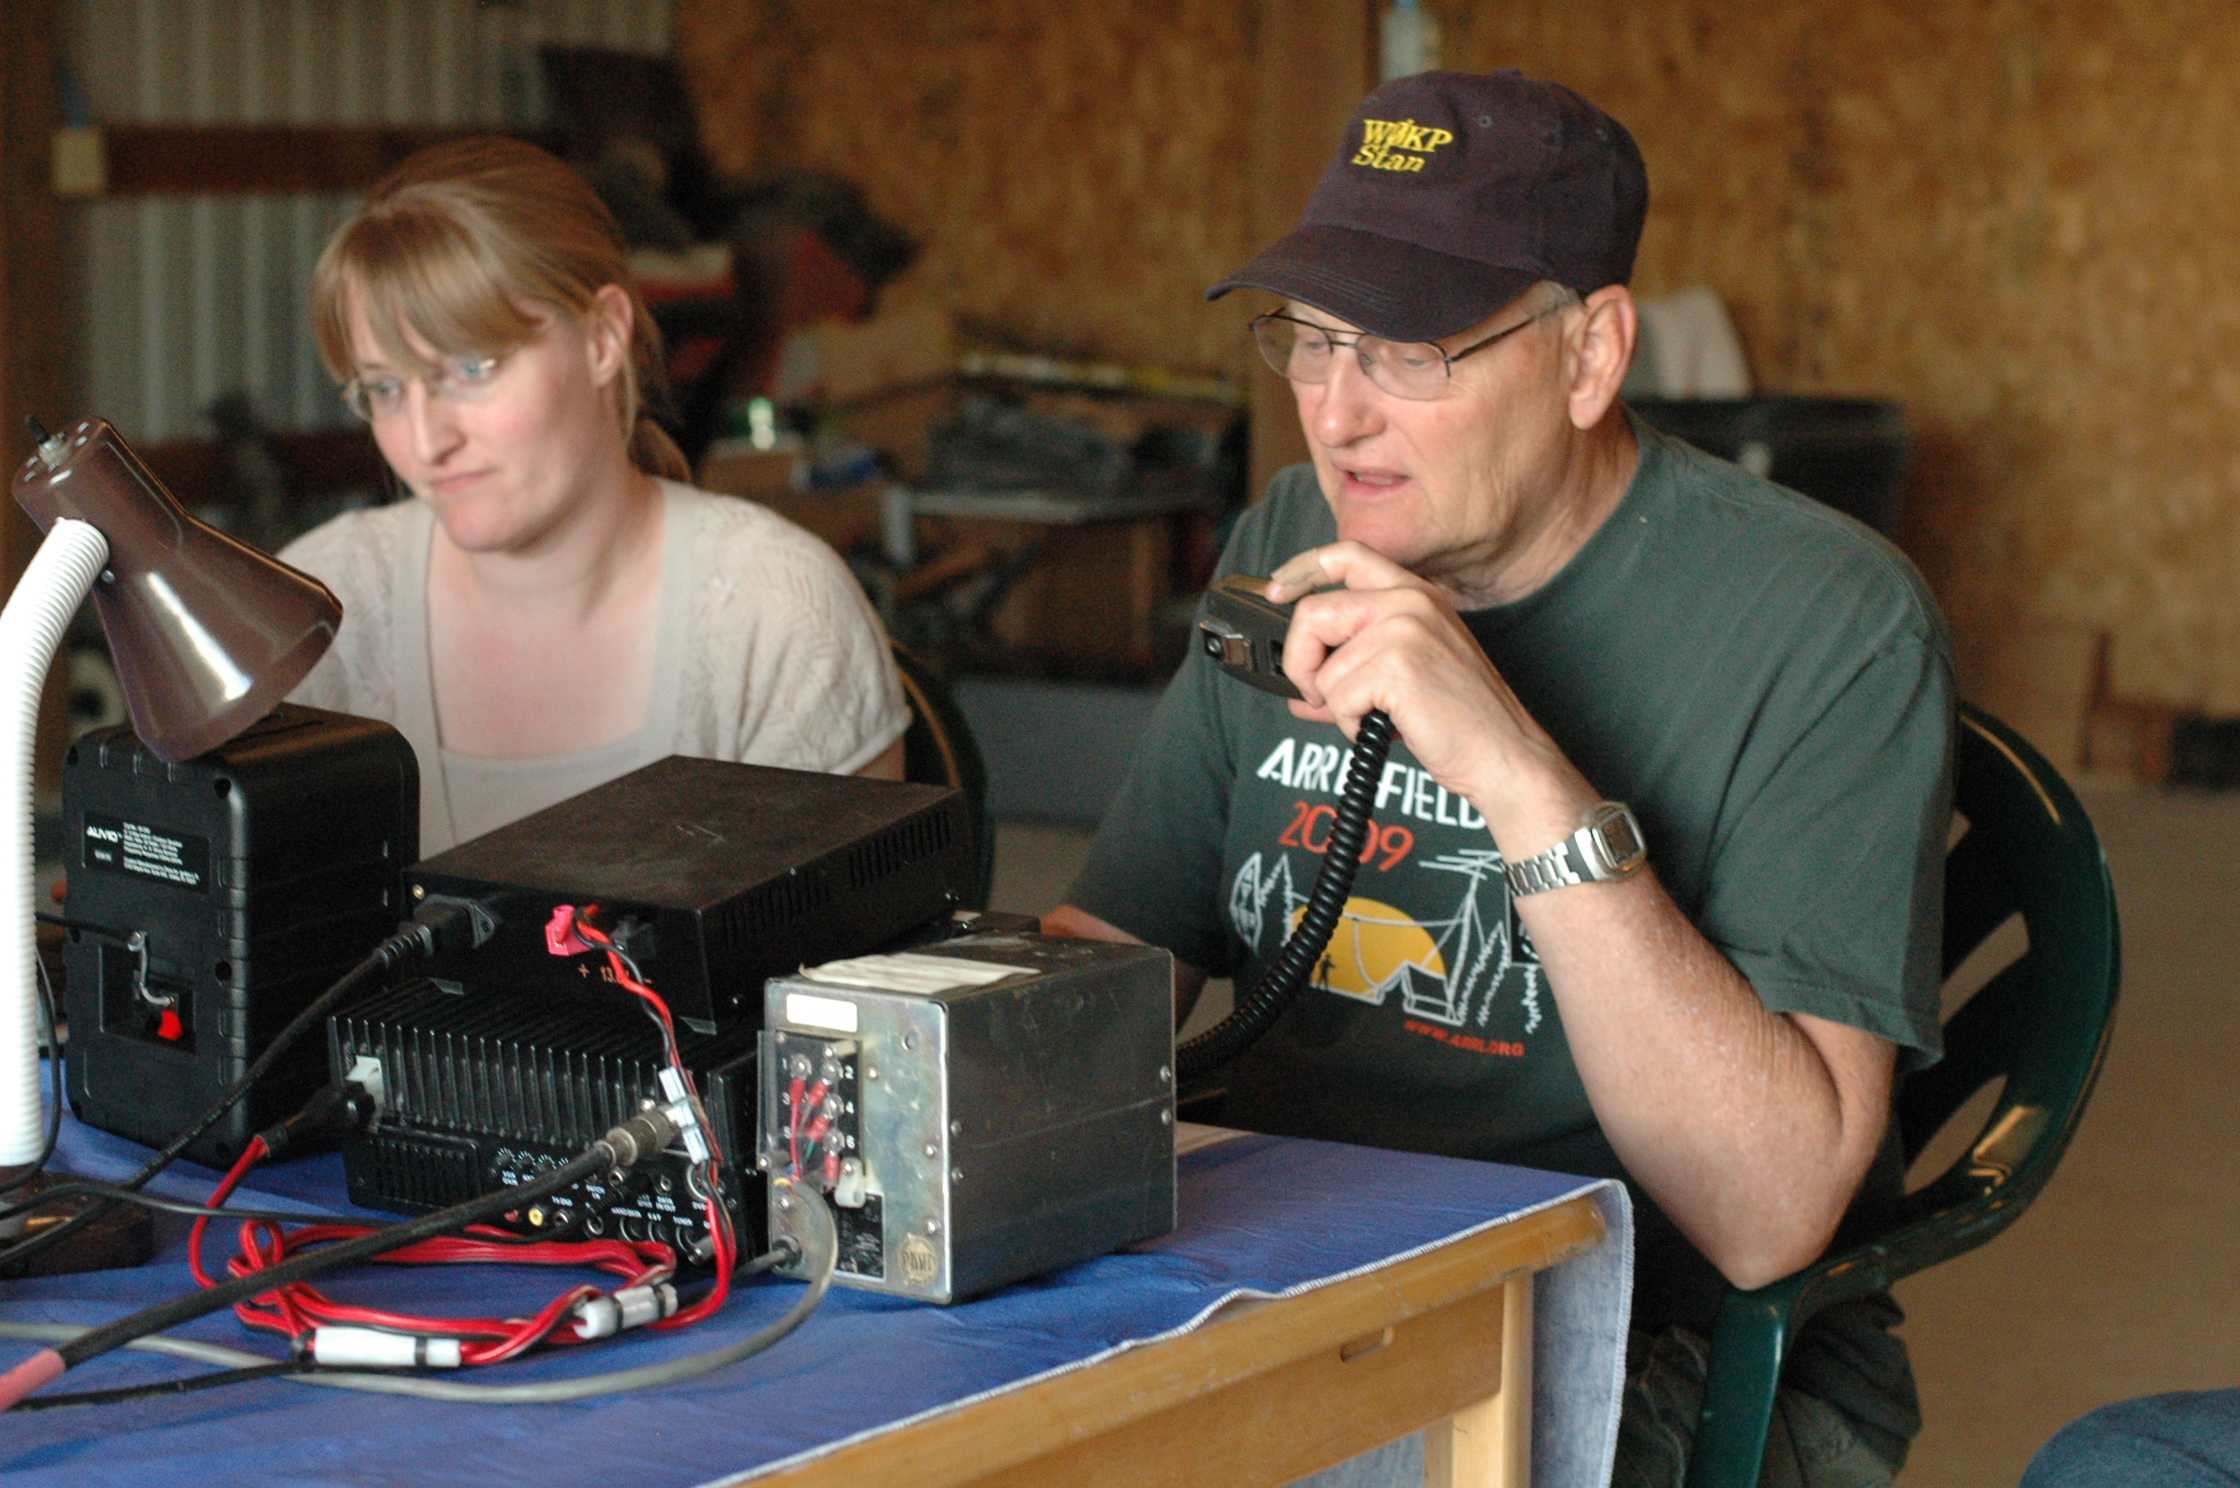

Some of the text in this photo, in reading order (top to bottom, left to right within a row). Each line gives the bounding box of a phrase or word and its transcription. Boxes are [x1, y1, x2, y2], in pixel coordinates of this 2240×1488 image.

[1352, 144, 1425, 173] Stan
[845, 1064, 854, 1080] 2
[845, 1100, 855, 1115] 4
[846, 1134, 856, 1150] 6
